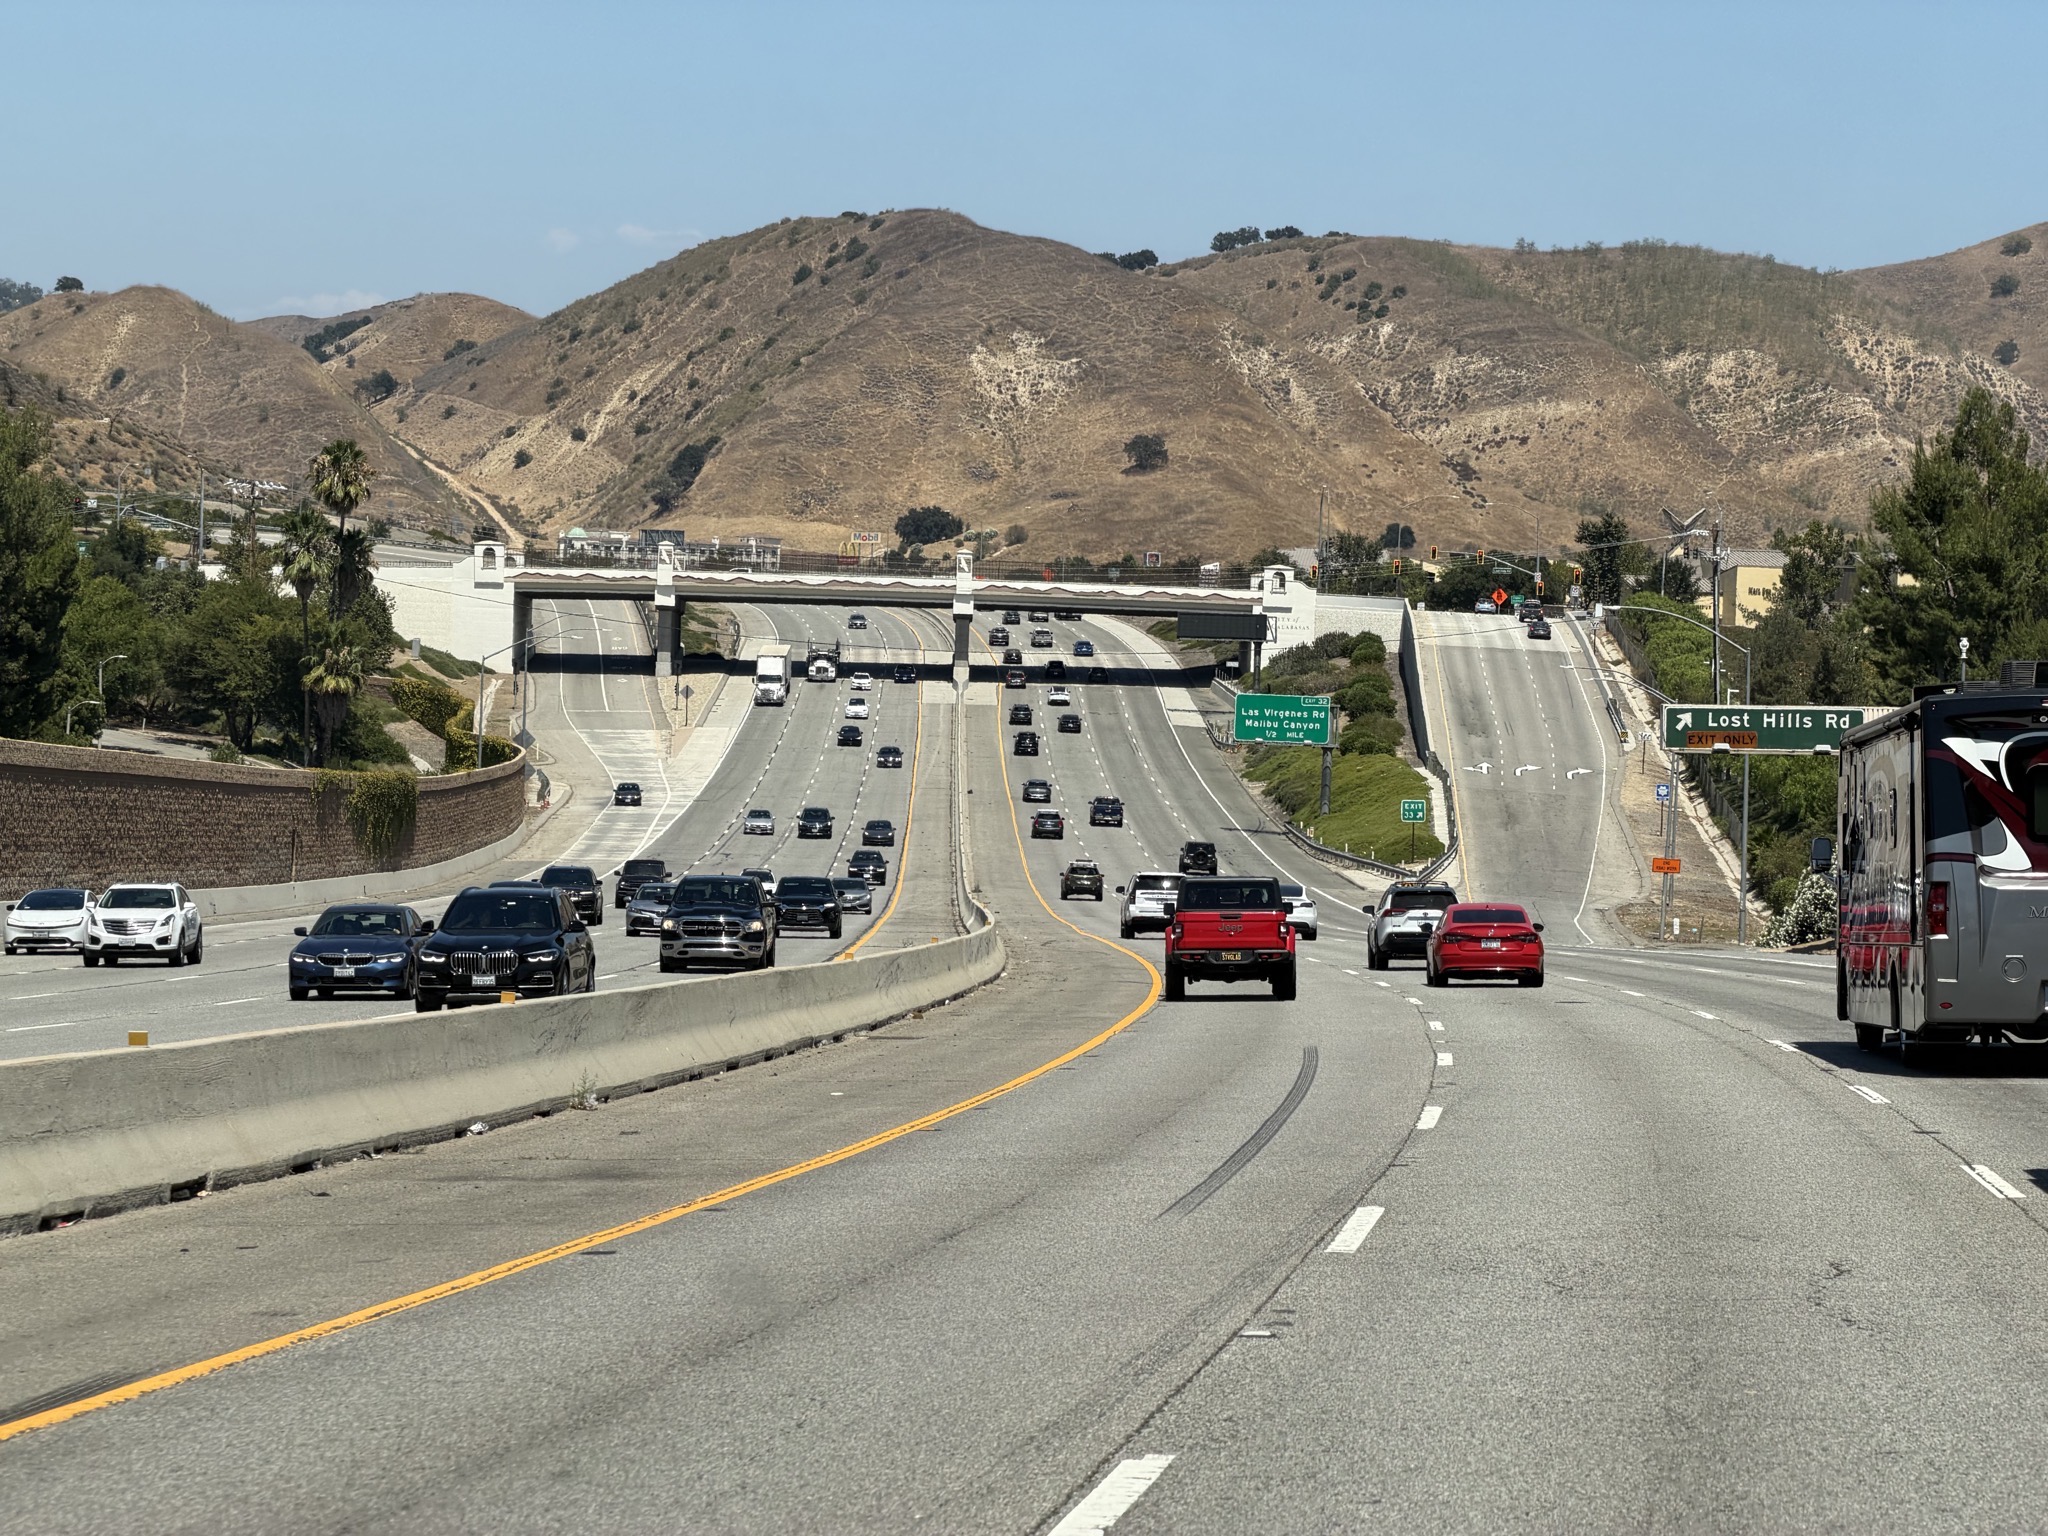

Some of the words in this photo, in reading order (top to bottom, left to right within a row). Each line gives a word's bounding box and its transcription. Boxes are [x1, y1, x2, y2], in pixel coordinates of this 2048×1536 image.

[1242, 708, 1259, 716] Las
[1264, 708, 1308, 719] Virgenes
[1312, 710, 1325, 719] Rd
[1245, 719, 1279, 728] Malibu
[1283, 720, 1321, 730] Canyon
[1708, 712, 1750, 728] Lost
[1763, 712, 1813, 729] Hills
[1825, 713, 1850, 729] Rd
[1265, 730, 1277, 738] 1/2
[1286, 731, 1304, 739] MILE
[1687, 735, 1716, 745] EXIT
[1723, 735, 1757, 745] ONLY
[1404, 811, 1414, 819] 33
[1218, 923, 1244, 932] Jeep
